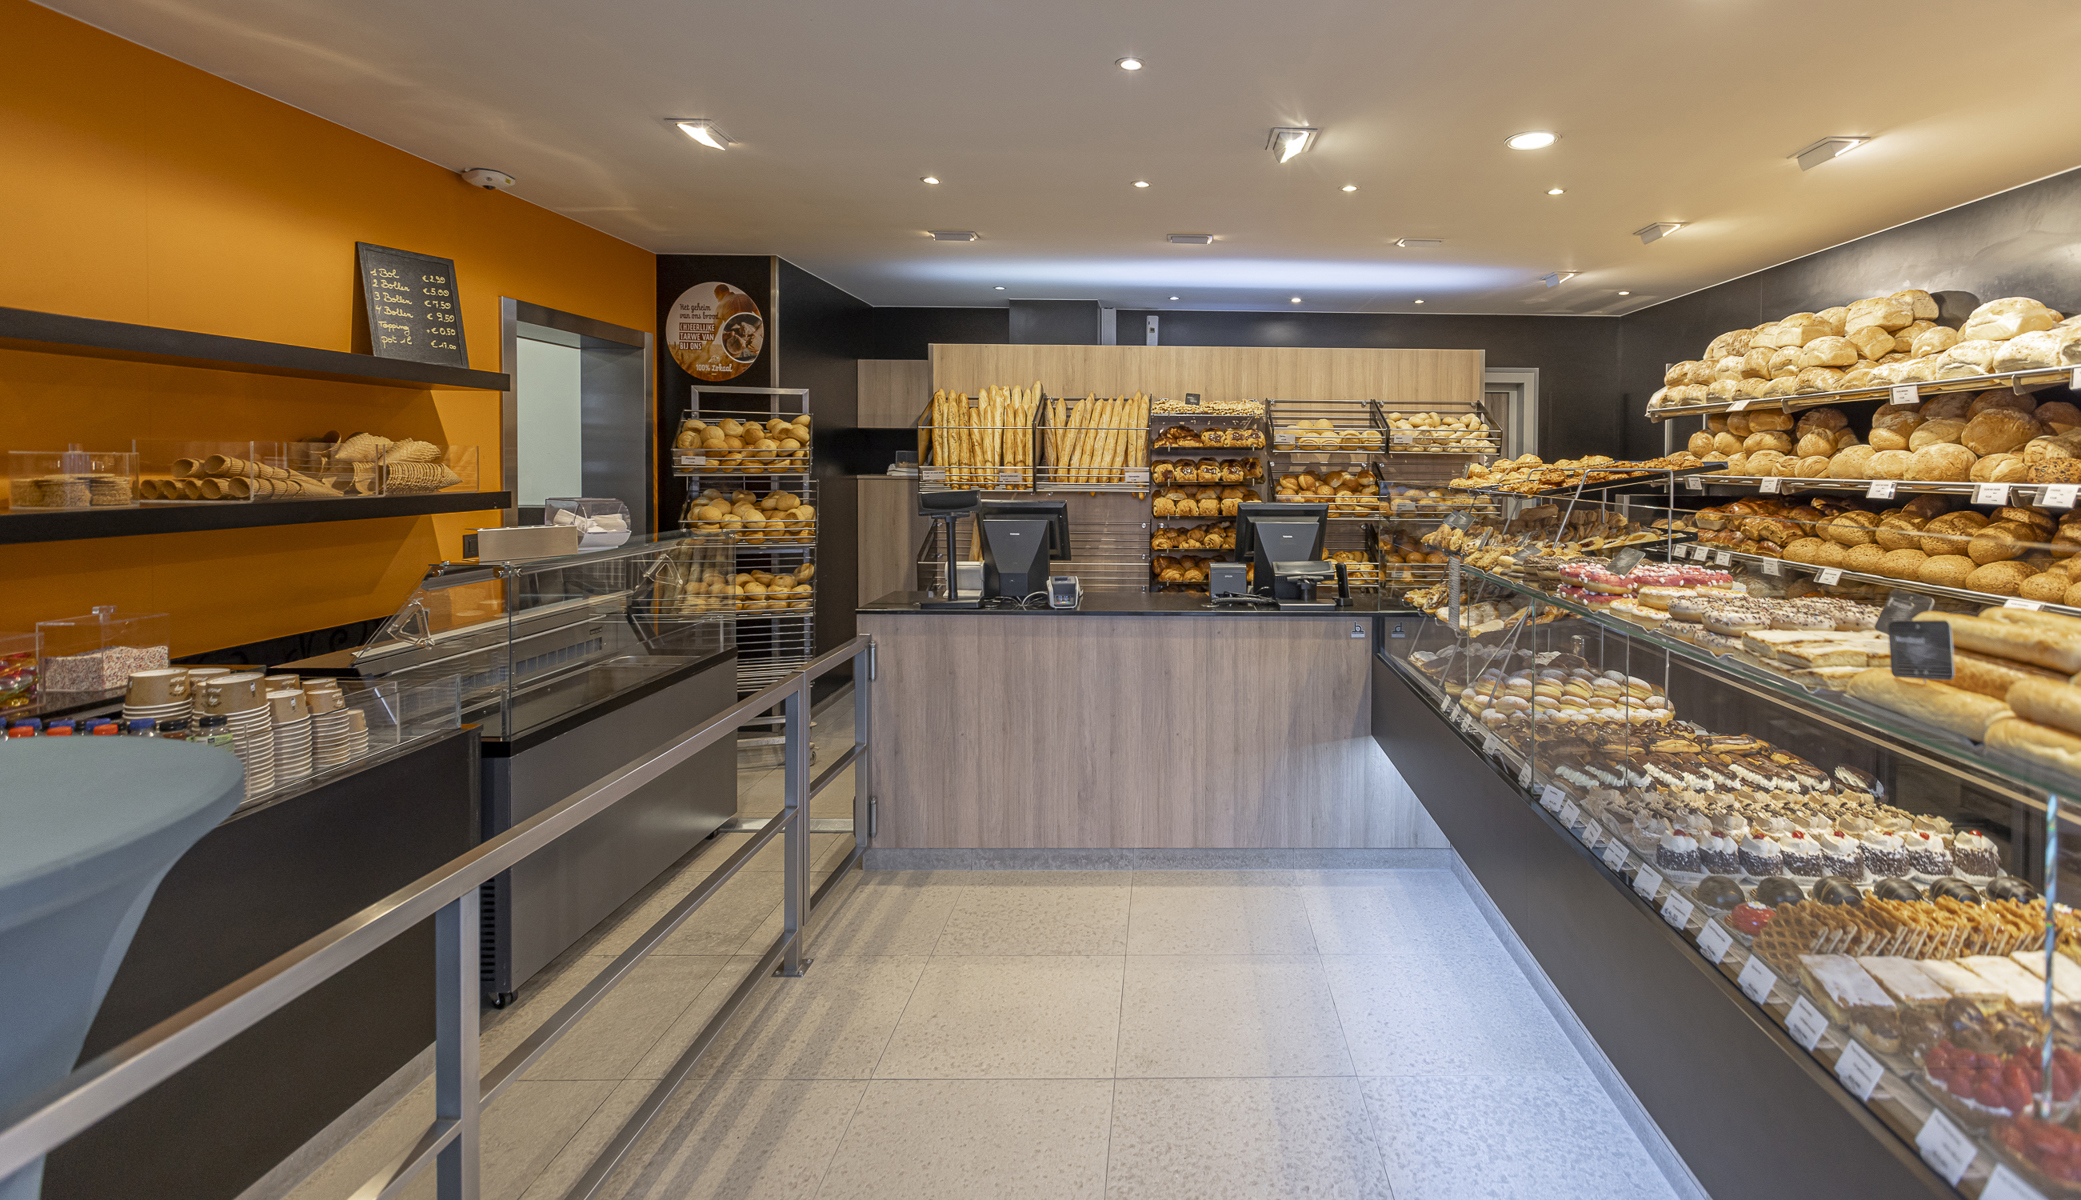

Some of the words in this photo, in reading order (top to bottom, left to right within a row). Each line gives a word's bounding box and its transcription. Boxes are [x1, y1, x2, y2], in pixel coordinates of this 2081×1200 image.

[370, 268, 377, 276] 1
[378, 268, 400, 279] Bol
[372, 278, 379, 288] 2
[380, 279, 410, 292] Bollen
[374, 291, 381, 301] 3
[382, 292, 413, 305] Bollen
[375, 305, 382, 314] 4
[383, 306, 414, 319] Bollen
[680, 303, 690, 311] Het
[690, 302, 711, 313] geheim
[377, 320, 411, 336] Topping
[680, 323, 715, 331] (H)EERLIJKE
[702, 333, 715, 341] VAN
[680, 342, 689, 350] BIJ
[690, 342, 702, 350] ONS
